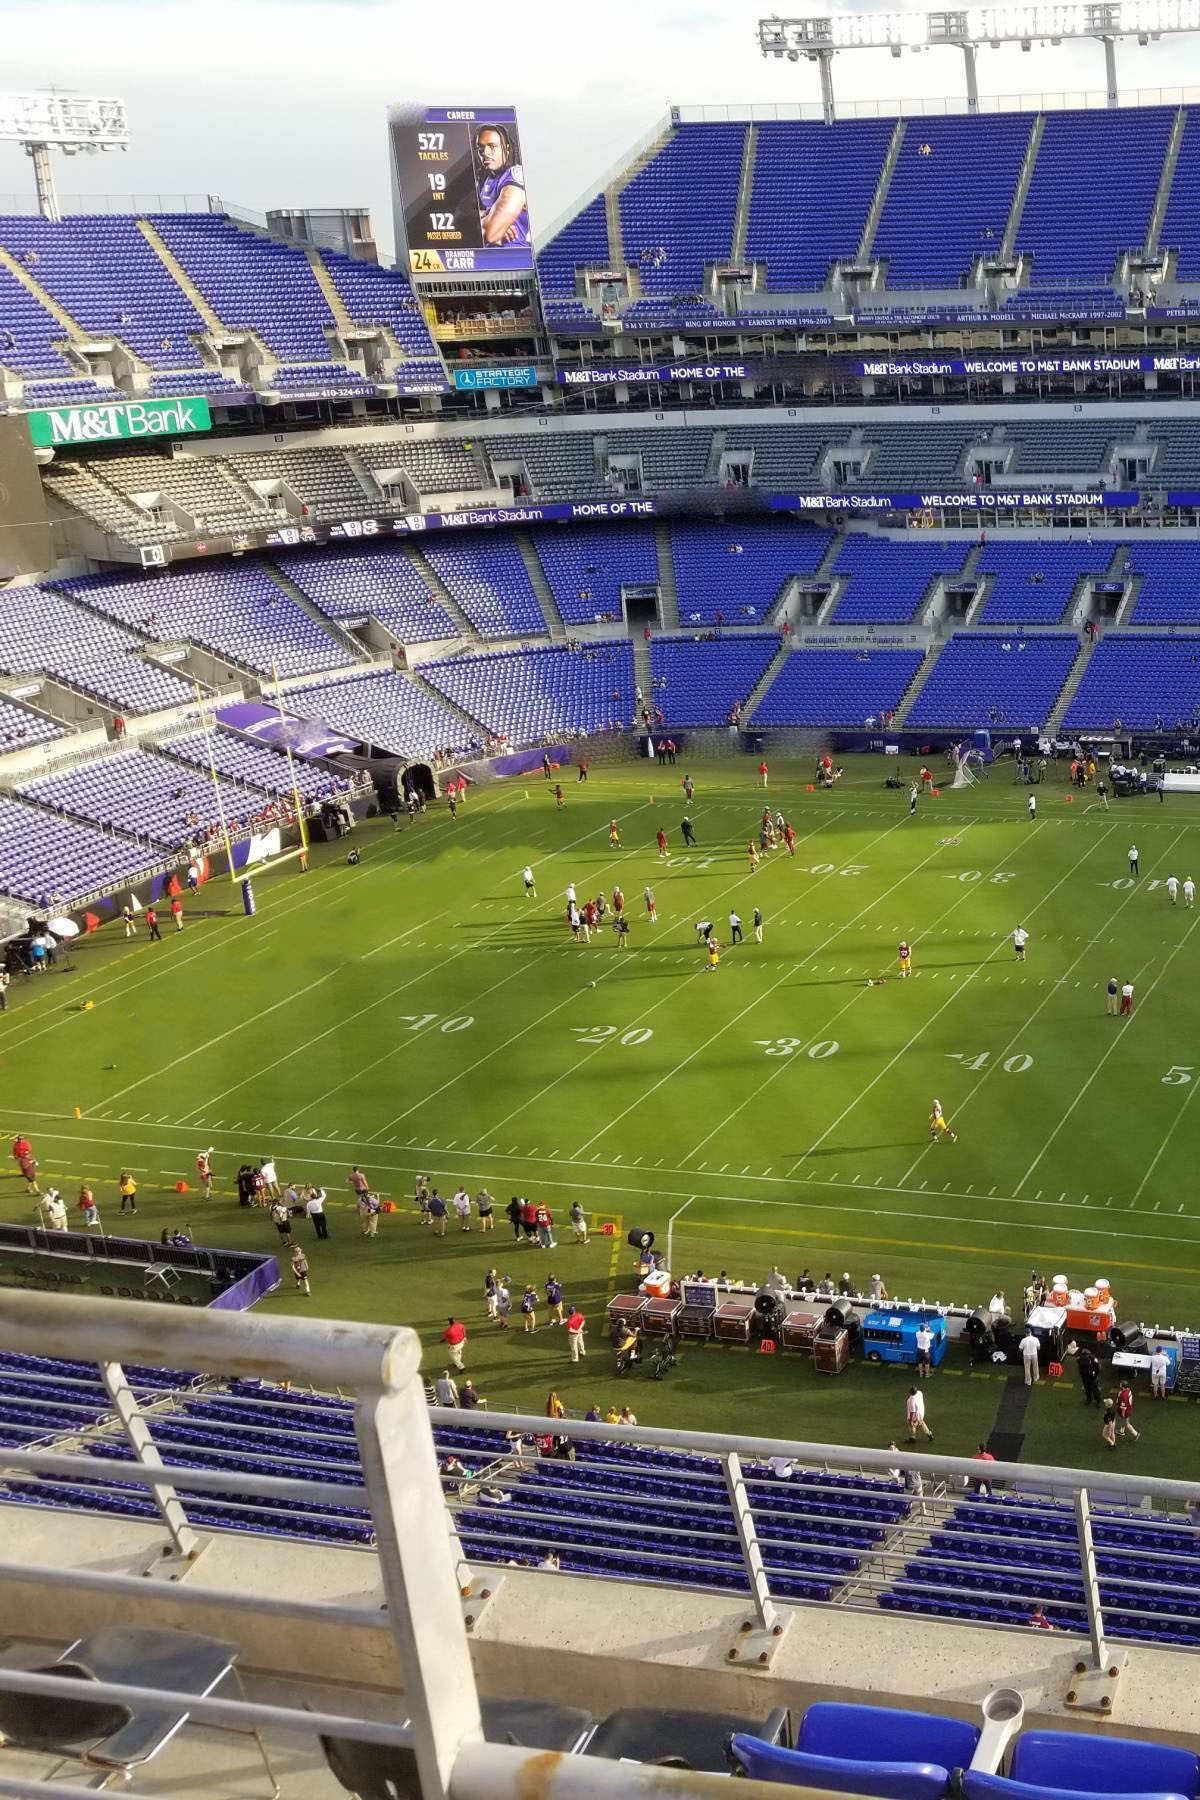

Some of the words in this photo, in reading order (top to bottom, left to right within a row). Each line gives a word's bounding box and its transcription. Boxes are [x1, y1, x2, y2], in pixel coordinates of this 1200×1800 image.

[446, 111, 475, 120] CAREER
[418, 133, 445, 150] 527
[418, 152, 449, 161] TACKLES
[428, 174, 446, 191] 19
[432, 192, 445, 200] INT
[430, 213, 455, 230] 122
[445, 250, 474, 258] BRANDON
[413, 252, 431, 270] 24
[446, 258, 475, 269] CARR
[956, 314, 982, 322] ARTHUR
[1031, 312, 1058, 320] MICHAEL
[864, 363, 888, 375] M&T
[889, 363, 912, 374] Bank
[913, 362, 952, 374] Stadium
[964, 361, 1018, 373] WELCOME
[1020, 361, 1036, 372] TO
[1037, 361, 1060, 372] M&T
[1062, 360, 1092, 371] BANK
[1093, 360, 1140, 370] STADIUM
[1154, 358, 1179, 370] M&T
[475, 369, 530, 377] STRATEGIC
[564, 371, 592, 383] M&T
[592, 370, 618, 382] Bank
[618, 369, 660, 381] Stadium
[670, 368, 703, 378] HOME
[706, 368, 720, 378] OF
[722, 366, 745, 377] THE
[476, 376, 531, 386] FACTORY
[403, 385, 445, 393] RAVENS
[48, 405, 125, 443] M&T
[126, 401, 197, 435] Bank
[800, 496, 824, 508] M&T
[826, 496, 851, 508] Bank
[851, 496, 892, 508] Stadium
[921, 495, 977, 506] WELCOME
[979, 494, 995, 506] TO
[997, 494, 1020, 506] M&T
[1023, 494, 1054, 505] BANK
[1055, 494, 1103, 504] STADIUM
[572, 504, 608, 516] HOME
[611, 503, 626, 514] OF
[629, 502, 653, 512] THE
[441, 513, 470, 527] M&T
[470, 512, 497, 524] Bank
[498, 509, 542, 522] Stadium
[808, 863, 870, 876] 20
[957, 869, 1017, 884] 30
[404, 1014, 475, 1033] 10
[575, 1025, 653, 1046] 20
[764, 1037, 840, 1058] 30
[960, 1051, 1034, 1073] 40
